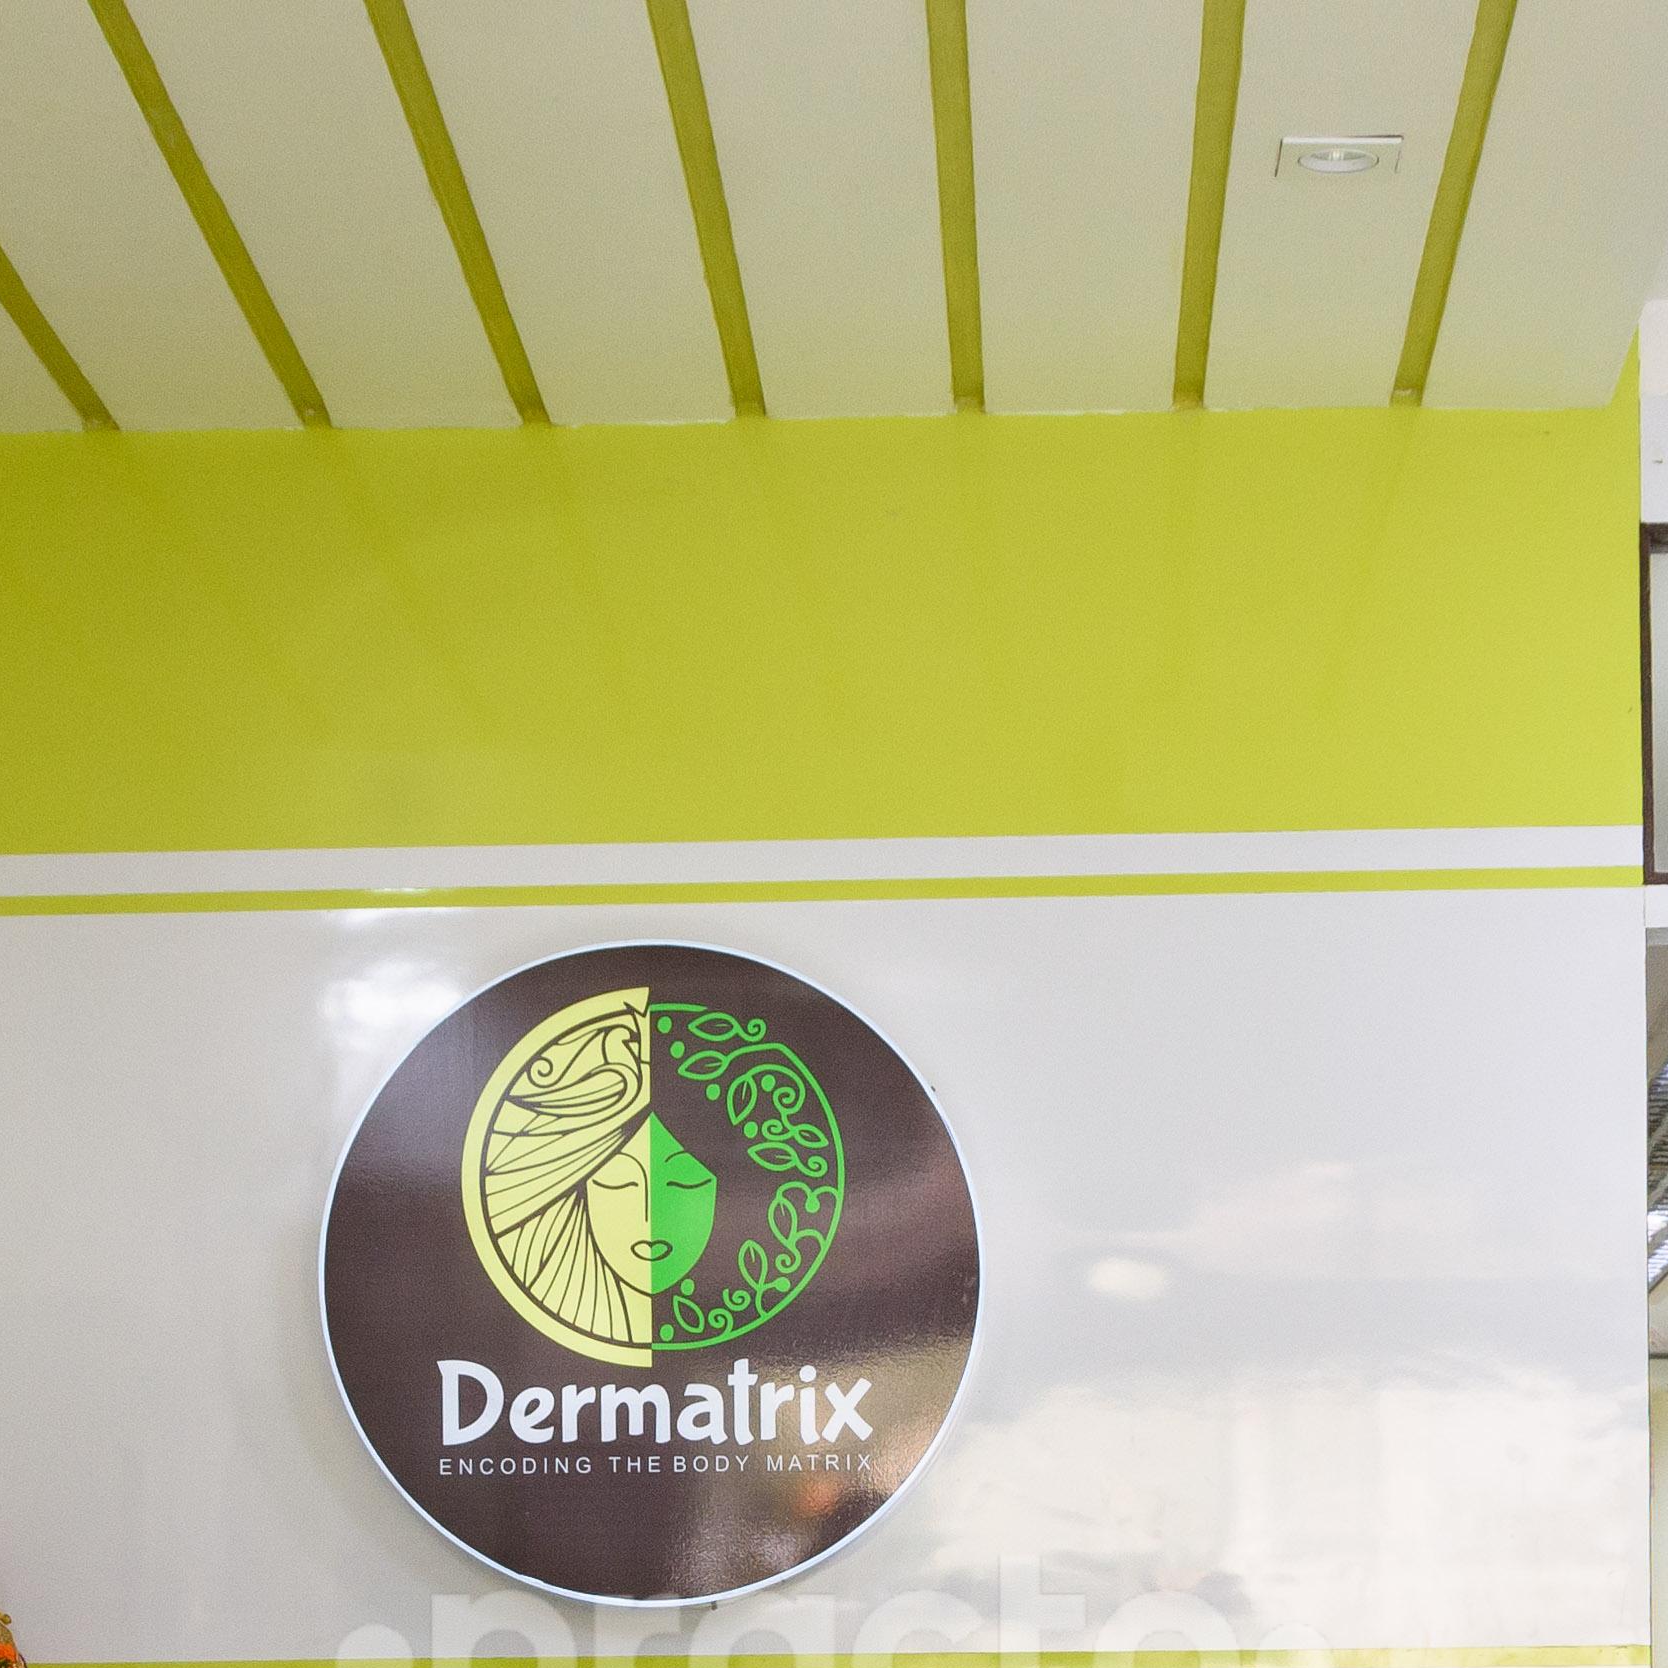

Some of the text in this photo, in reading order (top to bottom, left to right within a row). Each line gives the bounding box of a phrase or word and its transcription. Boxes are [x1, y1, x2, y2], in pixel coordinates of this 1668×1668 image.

[437, 1359, 873, 1446] Dermatrix
[439, 1453, 872, 1476] ENCODING THE BODY MATRIX
